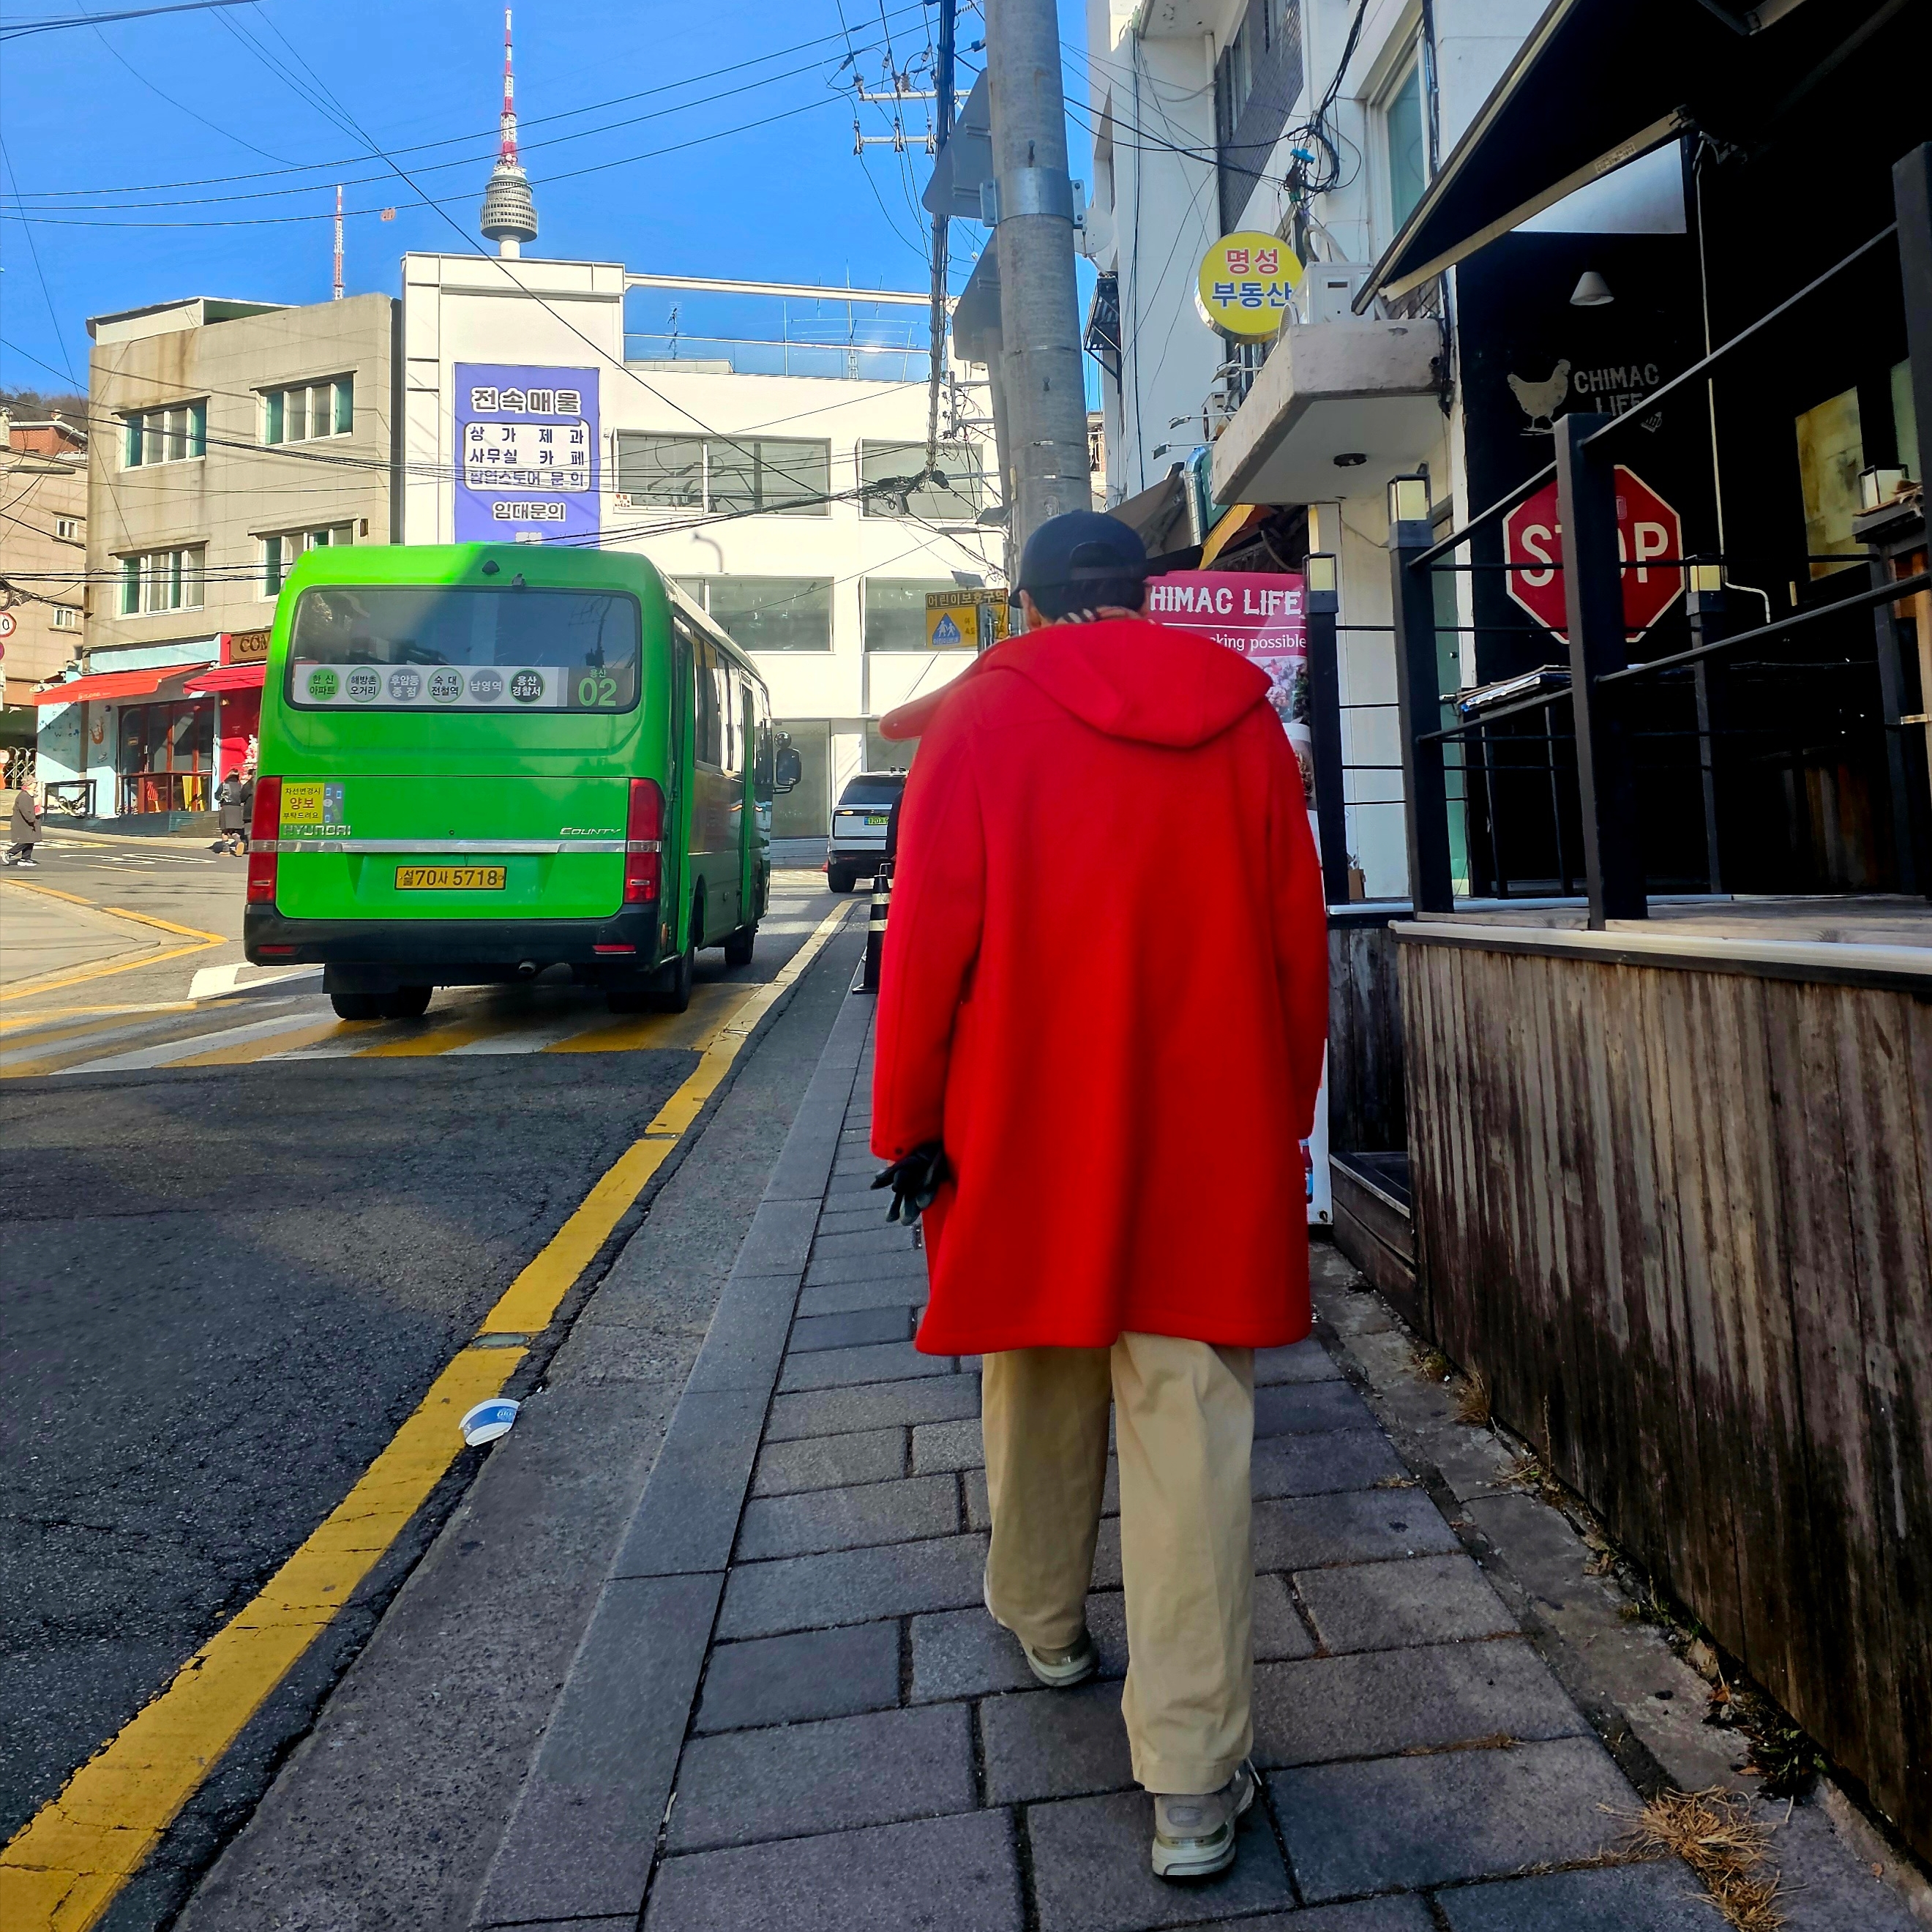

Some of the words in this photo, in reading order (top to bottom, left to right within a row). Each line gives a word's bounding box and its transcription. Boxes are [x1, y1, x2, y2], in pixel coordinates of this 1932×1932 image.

[1227, 248, 1278, 274] 명성
[1212, 282, 1292, 308] 부동산
[1574, 363, 1660, 394] CHIMAC
[473, 389, 580, 413] 전속매물
[469, 448, 517, 464] 사무실
[494, 503, 565, 520] 임대문의
[1520, 522, 1669, 587] SP
[928, 590, 1006, 607] 어린이보호구역
[1150, 585, 1234, 615] HIMAC
[1243, 588, 1302, 616] LIFE
[1210, 633, 1246, 651] king
[1250, 633, 1306, 652] possible
[351, 675, 377, 685] 해방촌
[589, 669, 607, 678] 용산
[390, 675, 419, 686] 후암동
[471, 681, 502, 692] 남영역
[517, 675, 537, 686] 용산
[310, 686, 336, 695] 아파트
[351, 686, 376, 695] 오거리
[431, 686, 459, 696] 전철역
[512, 686, 541, 697] 경찰서
[578, 677, 617, 707] 02
[285, 787, 321, 795] 차선변경시
[290, 797, 315, 810] 양보
[283, 812, 319, 820] 부탁드려요
[283, 825, 351, 836] HYUNDAI
[452, 869, 498, 886] 5718
